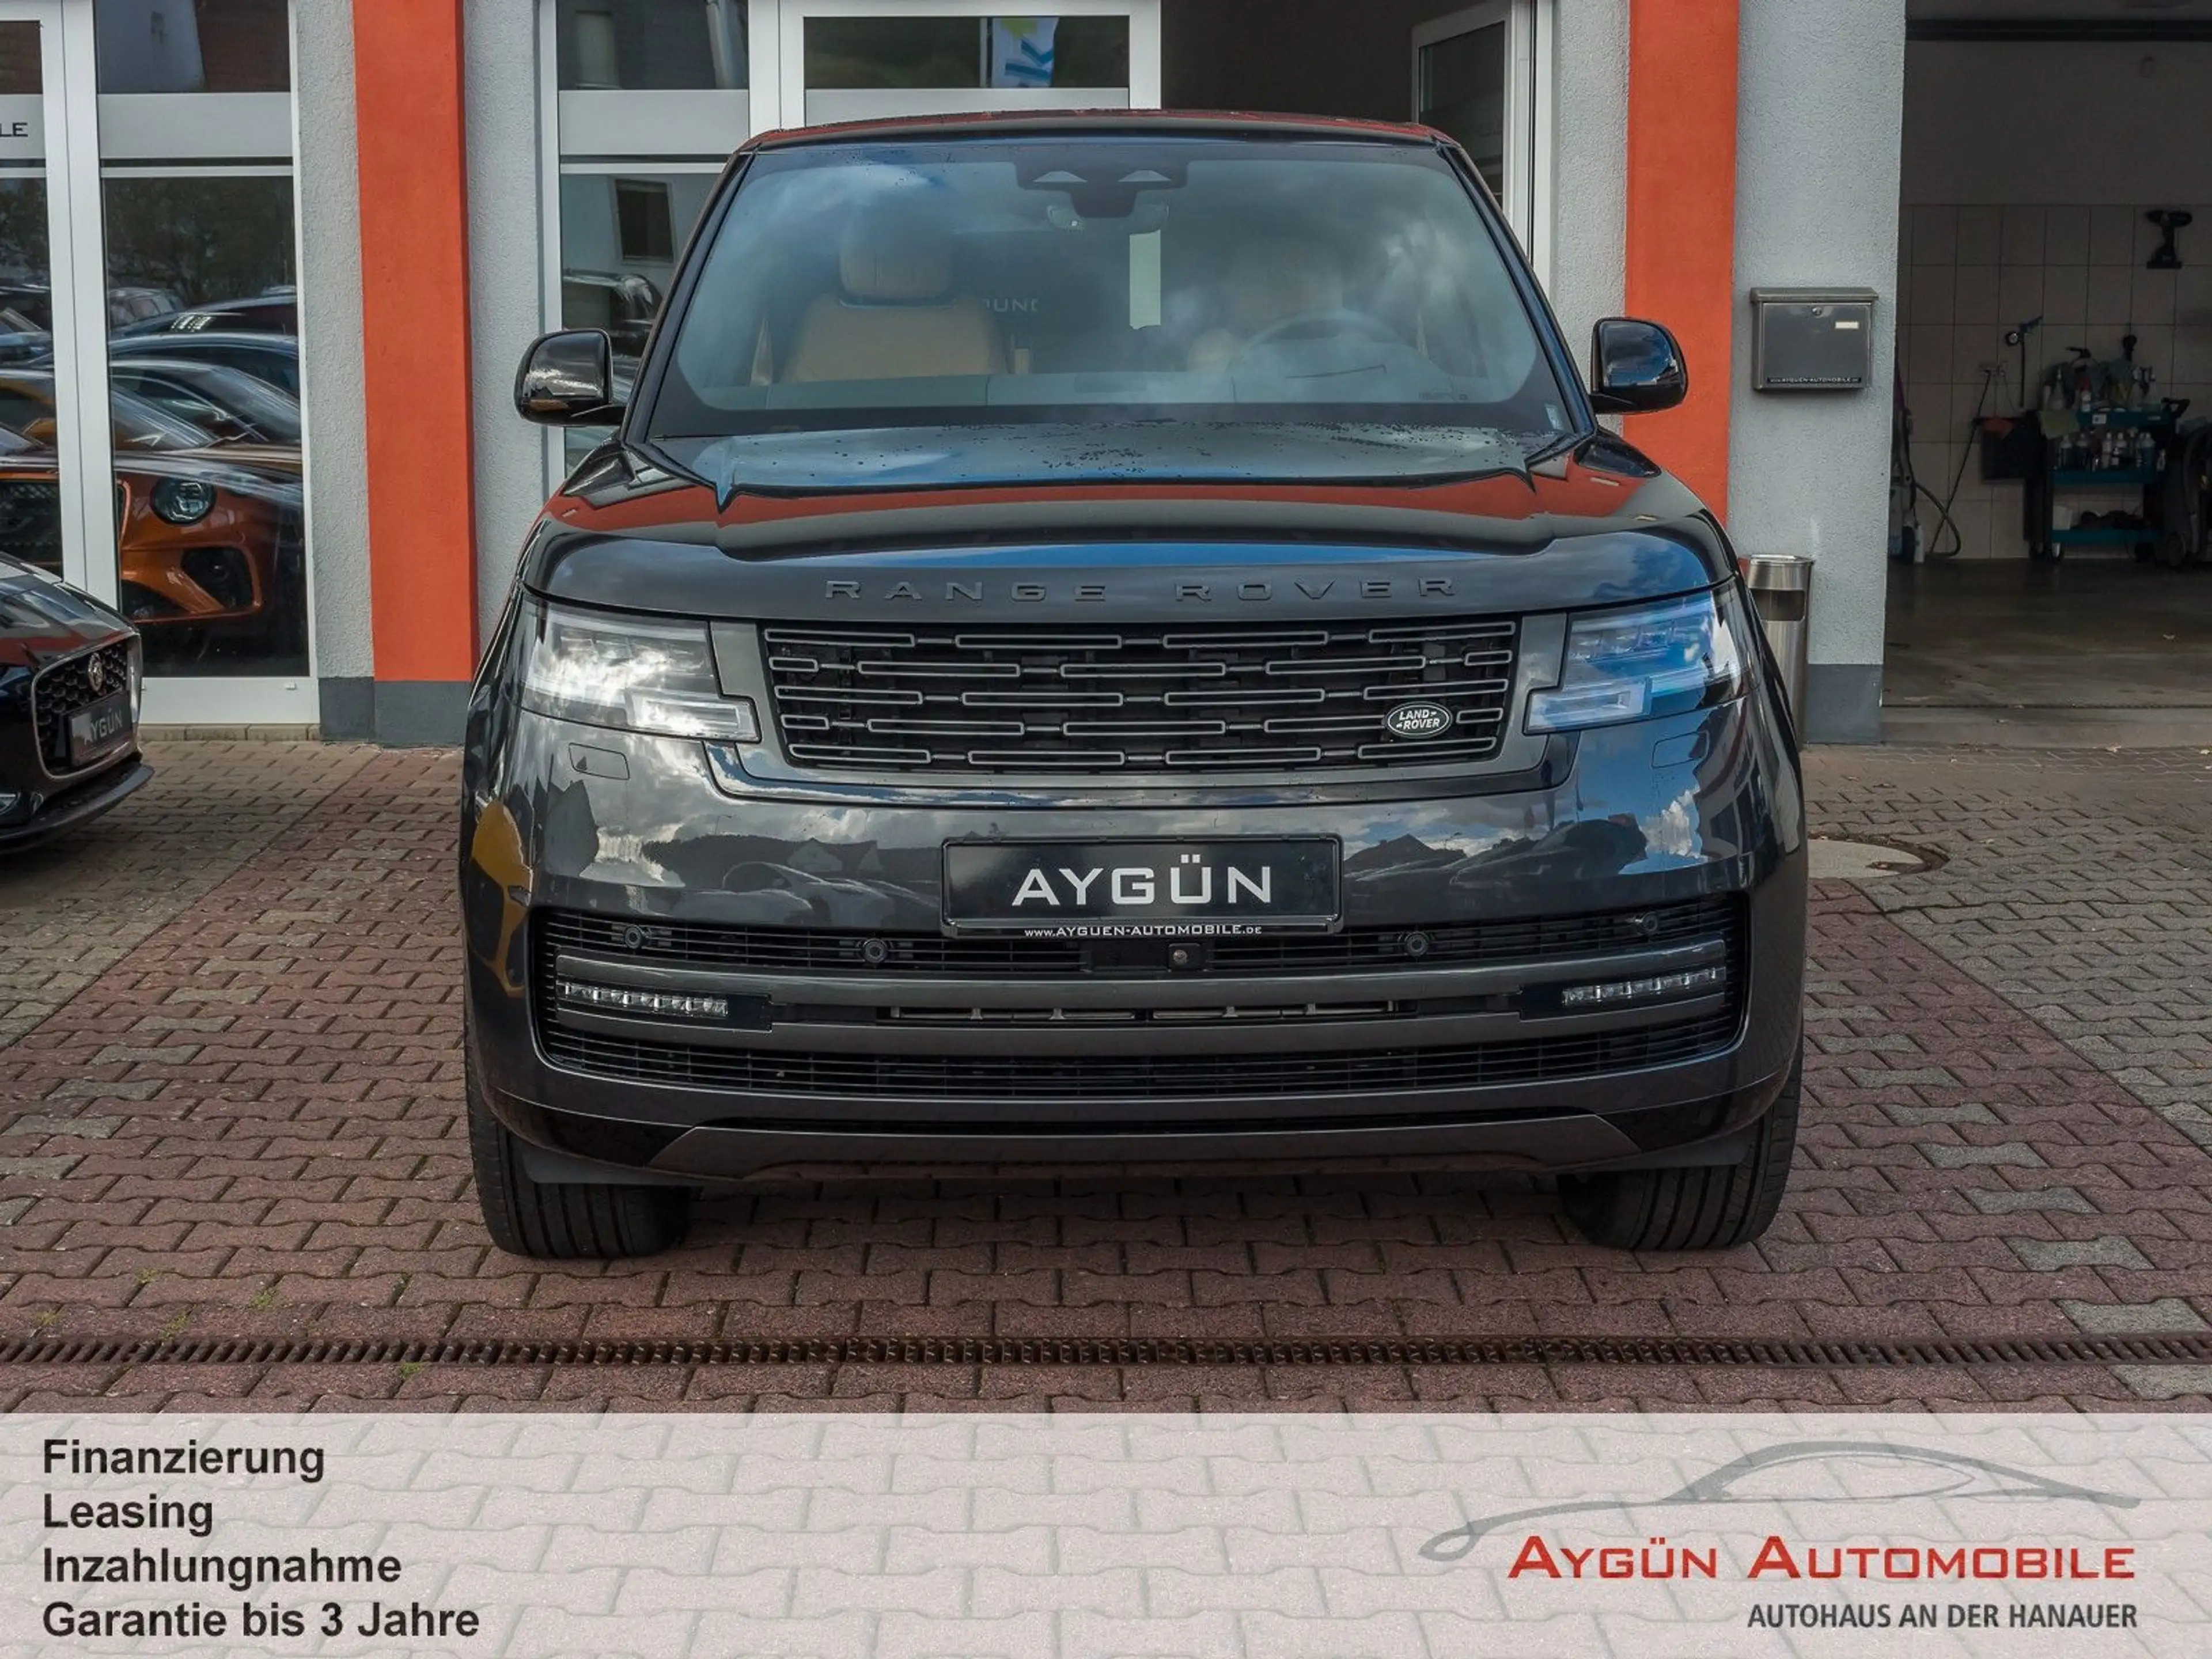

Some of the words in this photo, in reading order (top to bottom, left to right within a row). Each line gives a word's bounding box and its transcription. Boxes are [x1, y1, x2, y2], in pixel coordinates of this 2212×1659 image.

[825, 580, 1106, 603] RANGE
[1175, 577, 1455, 602] ROVER
[1399, 709, 1430, 721] LAND
[1403, 717, 1440, 730] ROVER
[1012, 854, 1271, 906] AYGÜN
